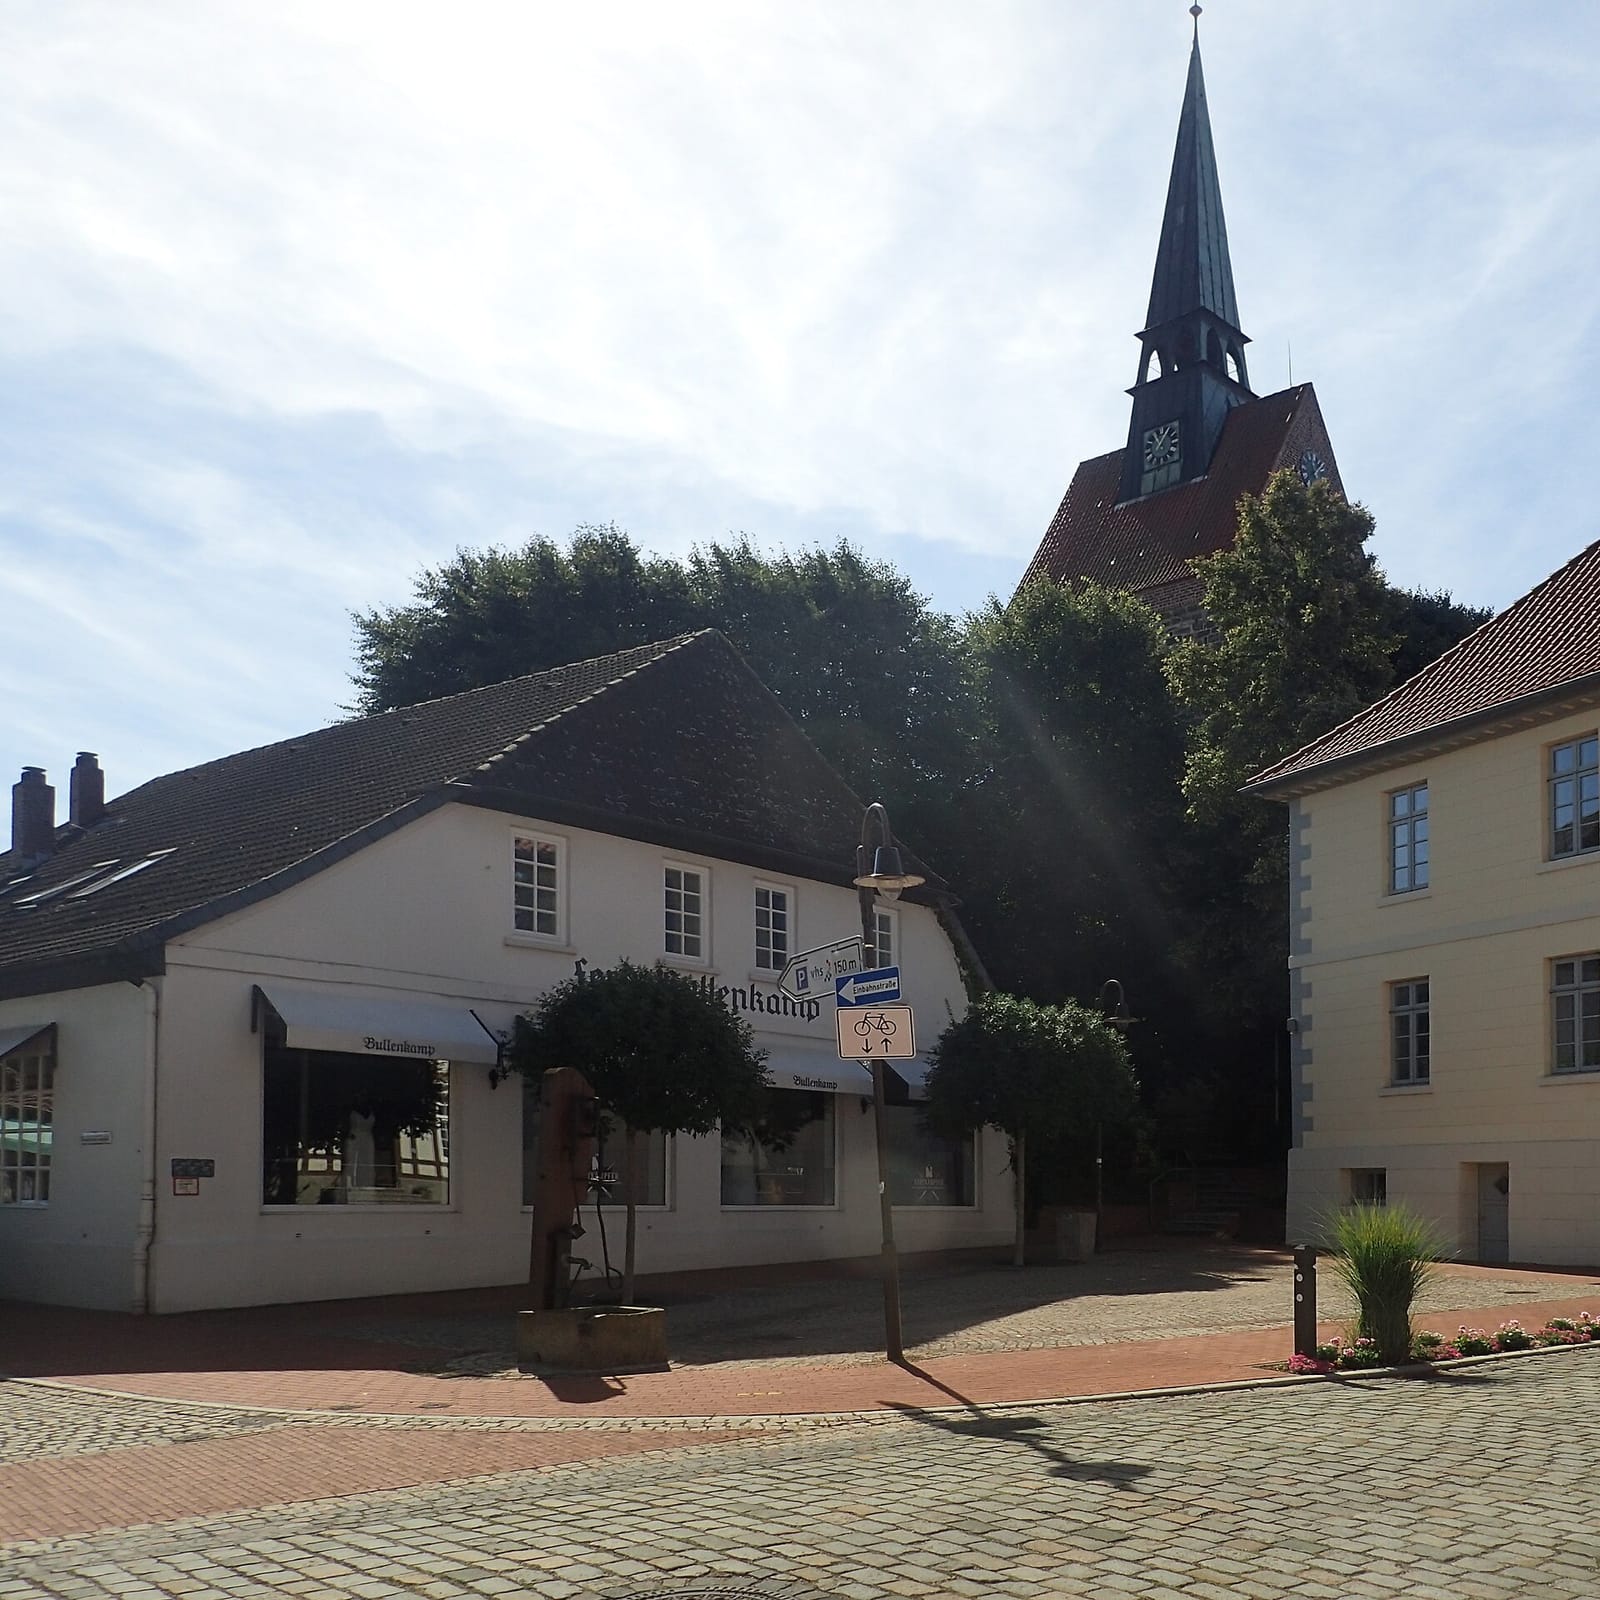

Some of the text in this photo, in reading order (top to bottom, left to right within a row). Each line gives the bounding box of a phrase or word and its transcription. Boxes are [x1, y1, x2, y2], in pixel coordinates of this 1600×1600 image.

[810, 966, 823, 979] vhs
[834, 960, 847, 974] 150
[849, 960, 857, 970] m
[853, 980, 896, 994] Einbahnstraße
[363, 1037, 436, 1056] Bullenkamp
[792, 1074, 838, 1090] Bullenkamp
